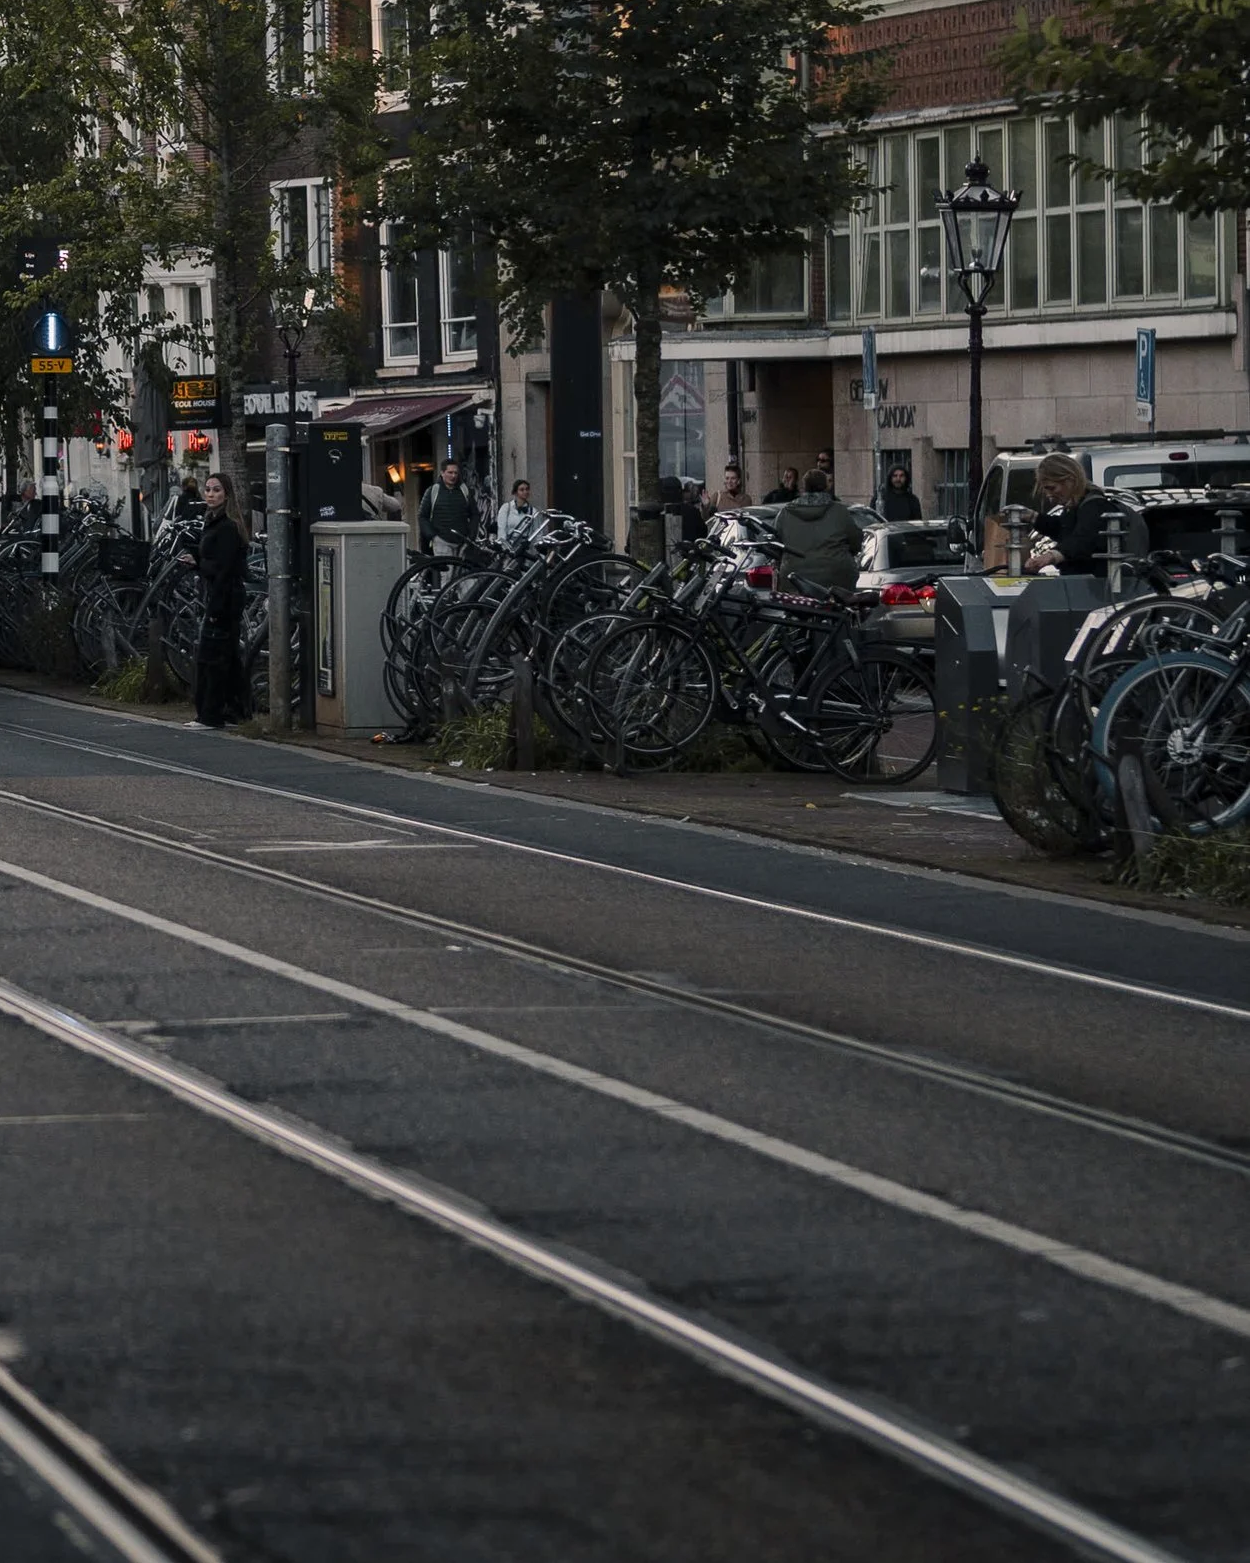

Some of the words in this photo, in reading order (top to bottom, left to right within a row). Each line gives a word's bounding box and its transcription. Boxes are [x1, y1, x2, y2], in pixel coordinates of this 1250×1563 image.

[1139, 334, 1148, 370] P
[192, 399, 217, 408] HOUSE
[244, 393, 274, 415] EOUL
